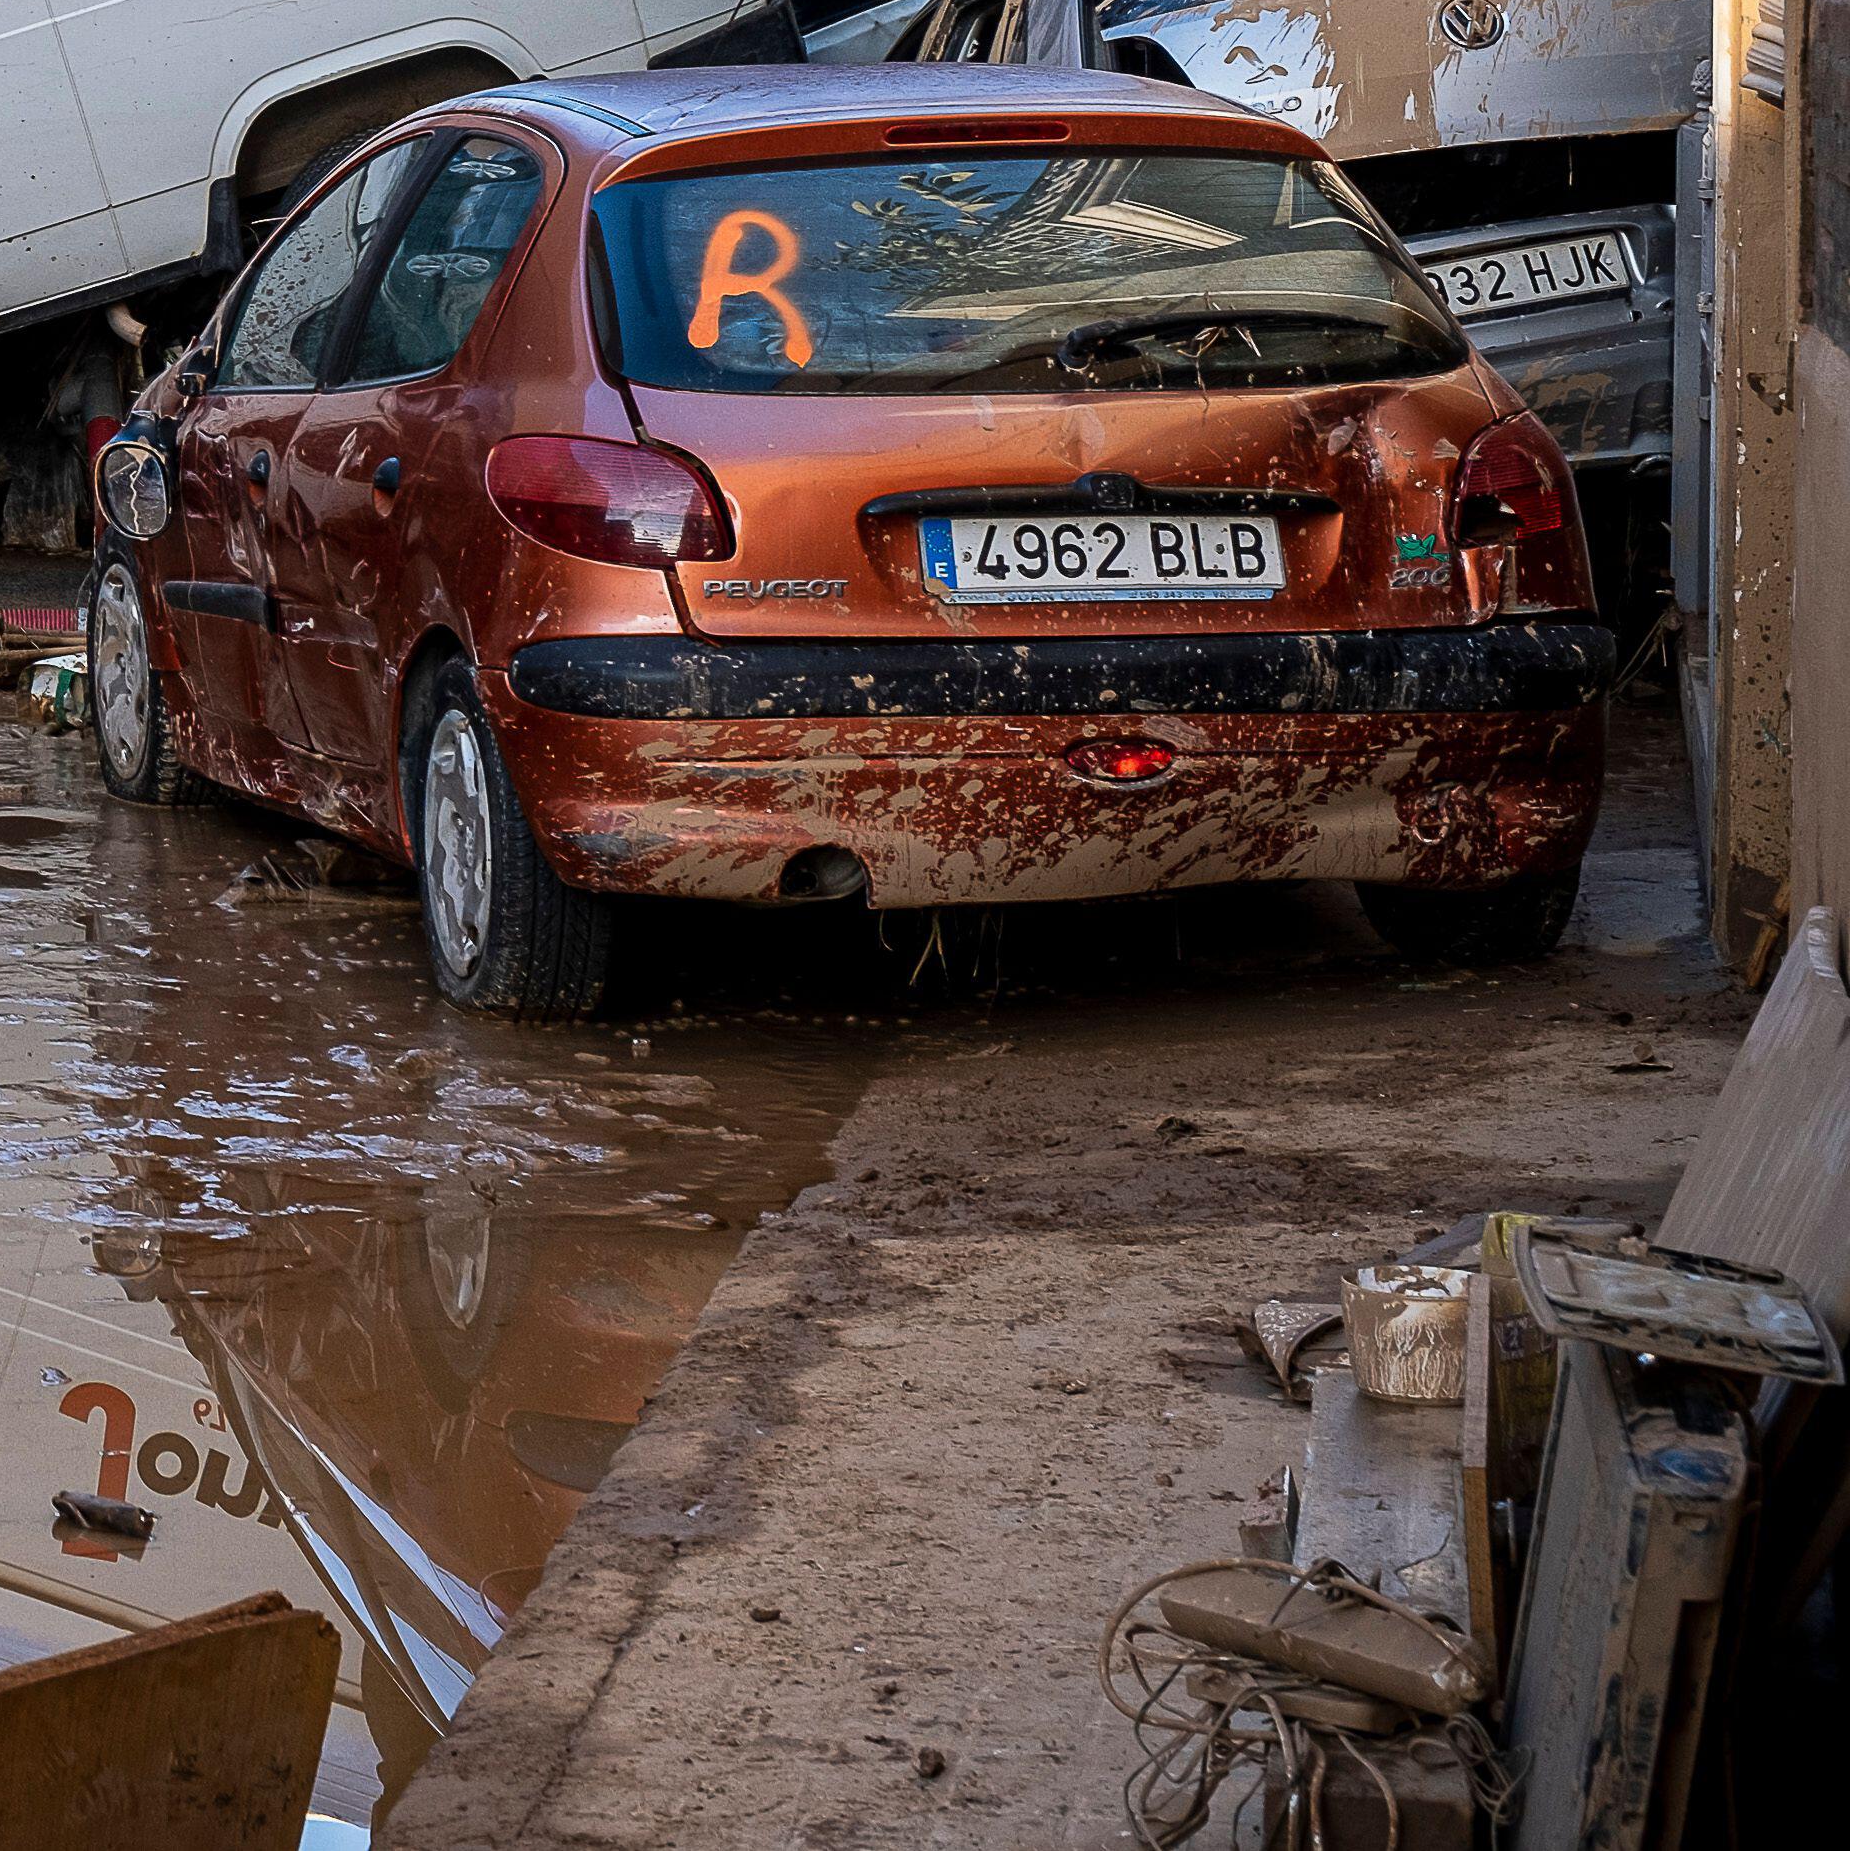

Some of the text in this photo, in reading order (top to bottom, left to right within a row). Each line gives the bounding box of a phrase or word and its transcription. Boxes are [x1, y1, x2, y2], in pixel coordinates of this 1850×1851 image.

[1521, 241, 1617, 294] HJK
[688, 209, 813, 368] R
[934, 561, 949, 579] E
[976, 521, 1267, 581] 4962 BLB
[702, 579, 849, 599] PEUGEOT
[1386, 564, 1451, 589] 206
